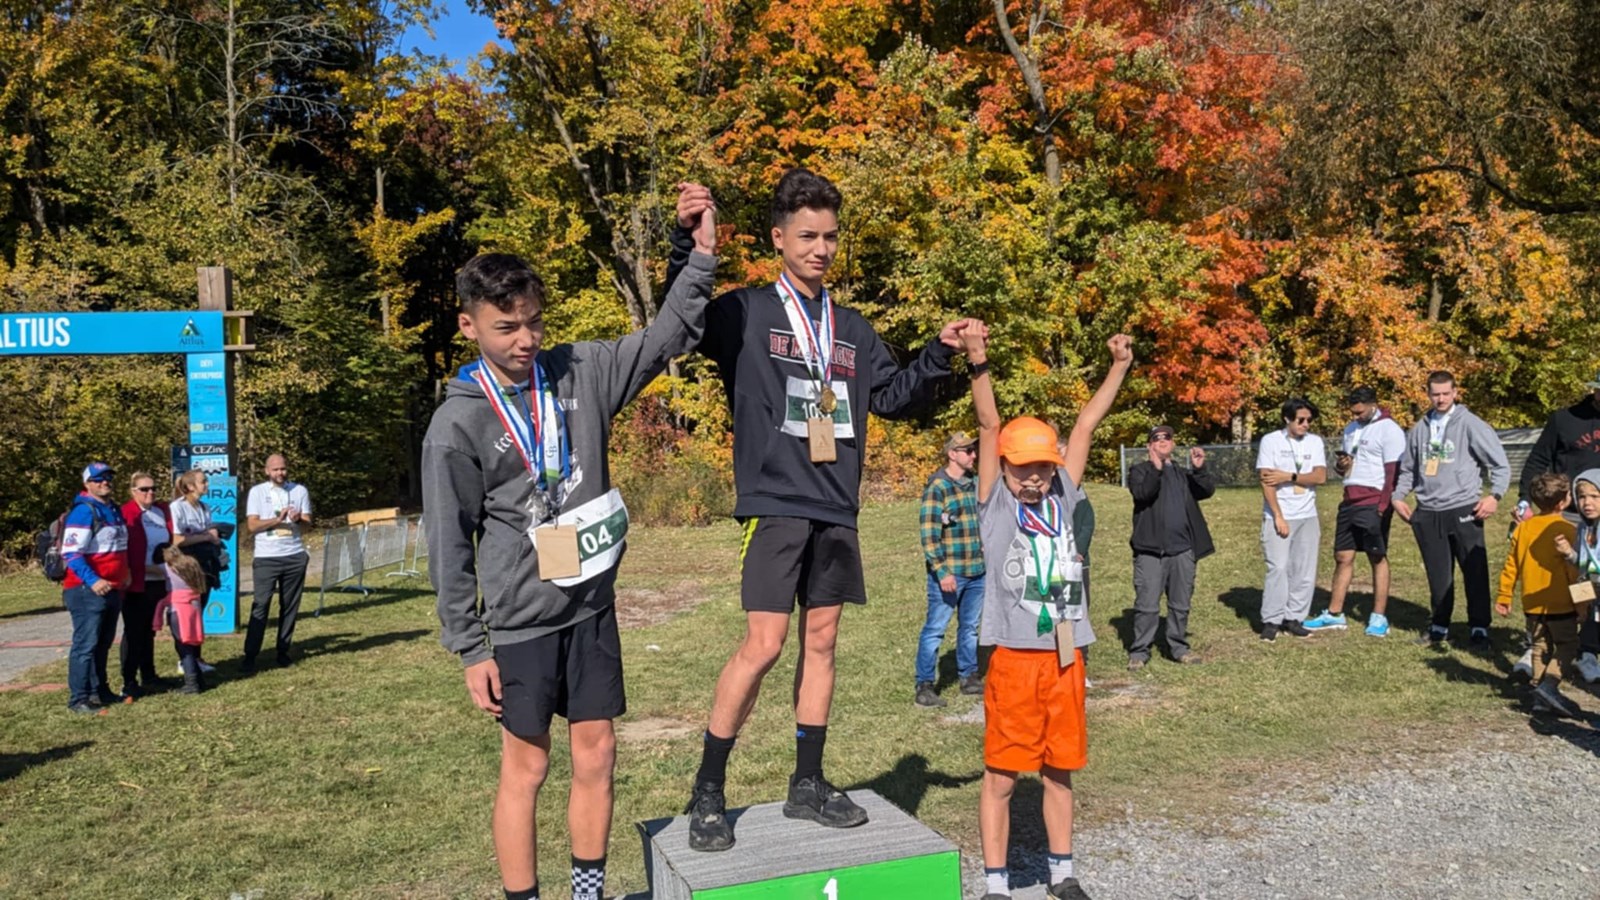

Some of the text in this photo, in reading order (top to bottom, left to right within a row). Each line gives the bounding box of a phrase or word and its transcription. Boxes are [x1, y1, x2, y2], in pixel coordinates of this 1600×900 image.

[770, 333, 789, 356] DE
[203, 423, 226, 431] DPJL
[192, 445, 226, 454] CEZinc
[580, 524, 613, 559] 04
[823, 877, 837, 900] 1
